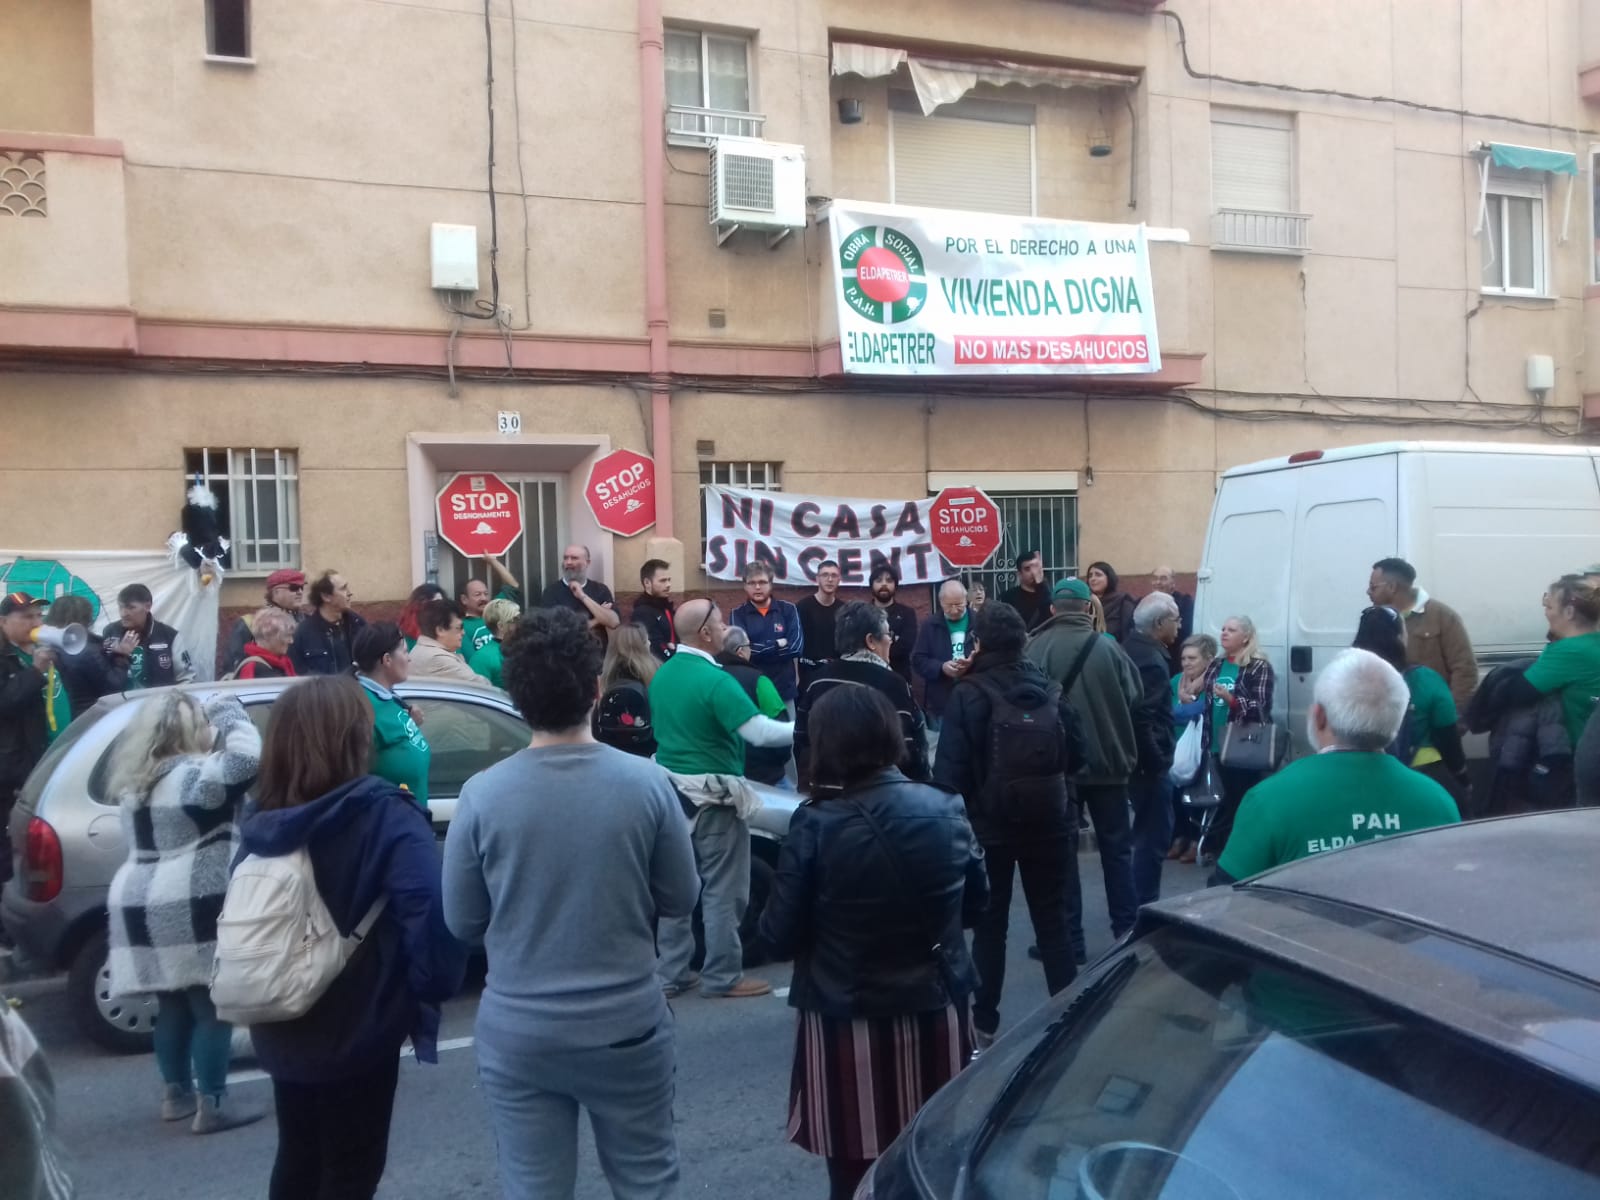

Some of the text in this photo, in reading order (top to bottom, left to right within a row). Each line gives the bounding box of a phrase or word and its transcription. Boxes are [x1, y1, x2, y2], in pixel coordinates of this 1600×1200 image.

[844, 233, 919, 273] OBRA SOCIAL
[945, 236, 1137, 256] POR EL DERECHO A UNA
[860, 266, 908, 284] ELDAPETRER
[940, 276, 1142, 316] VIVIENDA DIGNA
[959, 339, 1147, 360] NO MAS DESAHUCIOS
[500, 416, 519, 430] 30
[594, 462, 644, 500] STOP
[450, 492, 509, 512] STOP
[602, 478, 651, 510] DESAHUCIOS
[720, 494, 926, 539] NI CASA
[939, 507, 987, 525] STOP
[940, 525, 989, 534] DESAHUCIOS
[708, 535, 788, 581] SIN
[1352, 813, 1401, 830] PAH
[1307, 835, 1356, 853] ELDA
